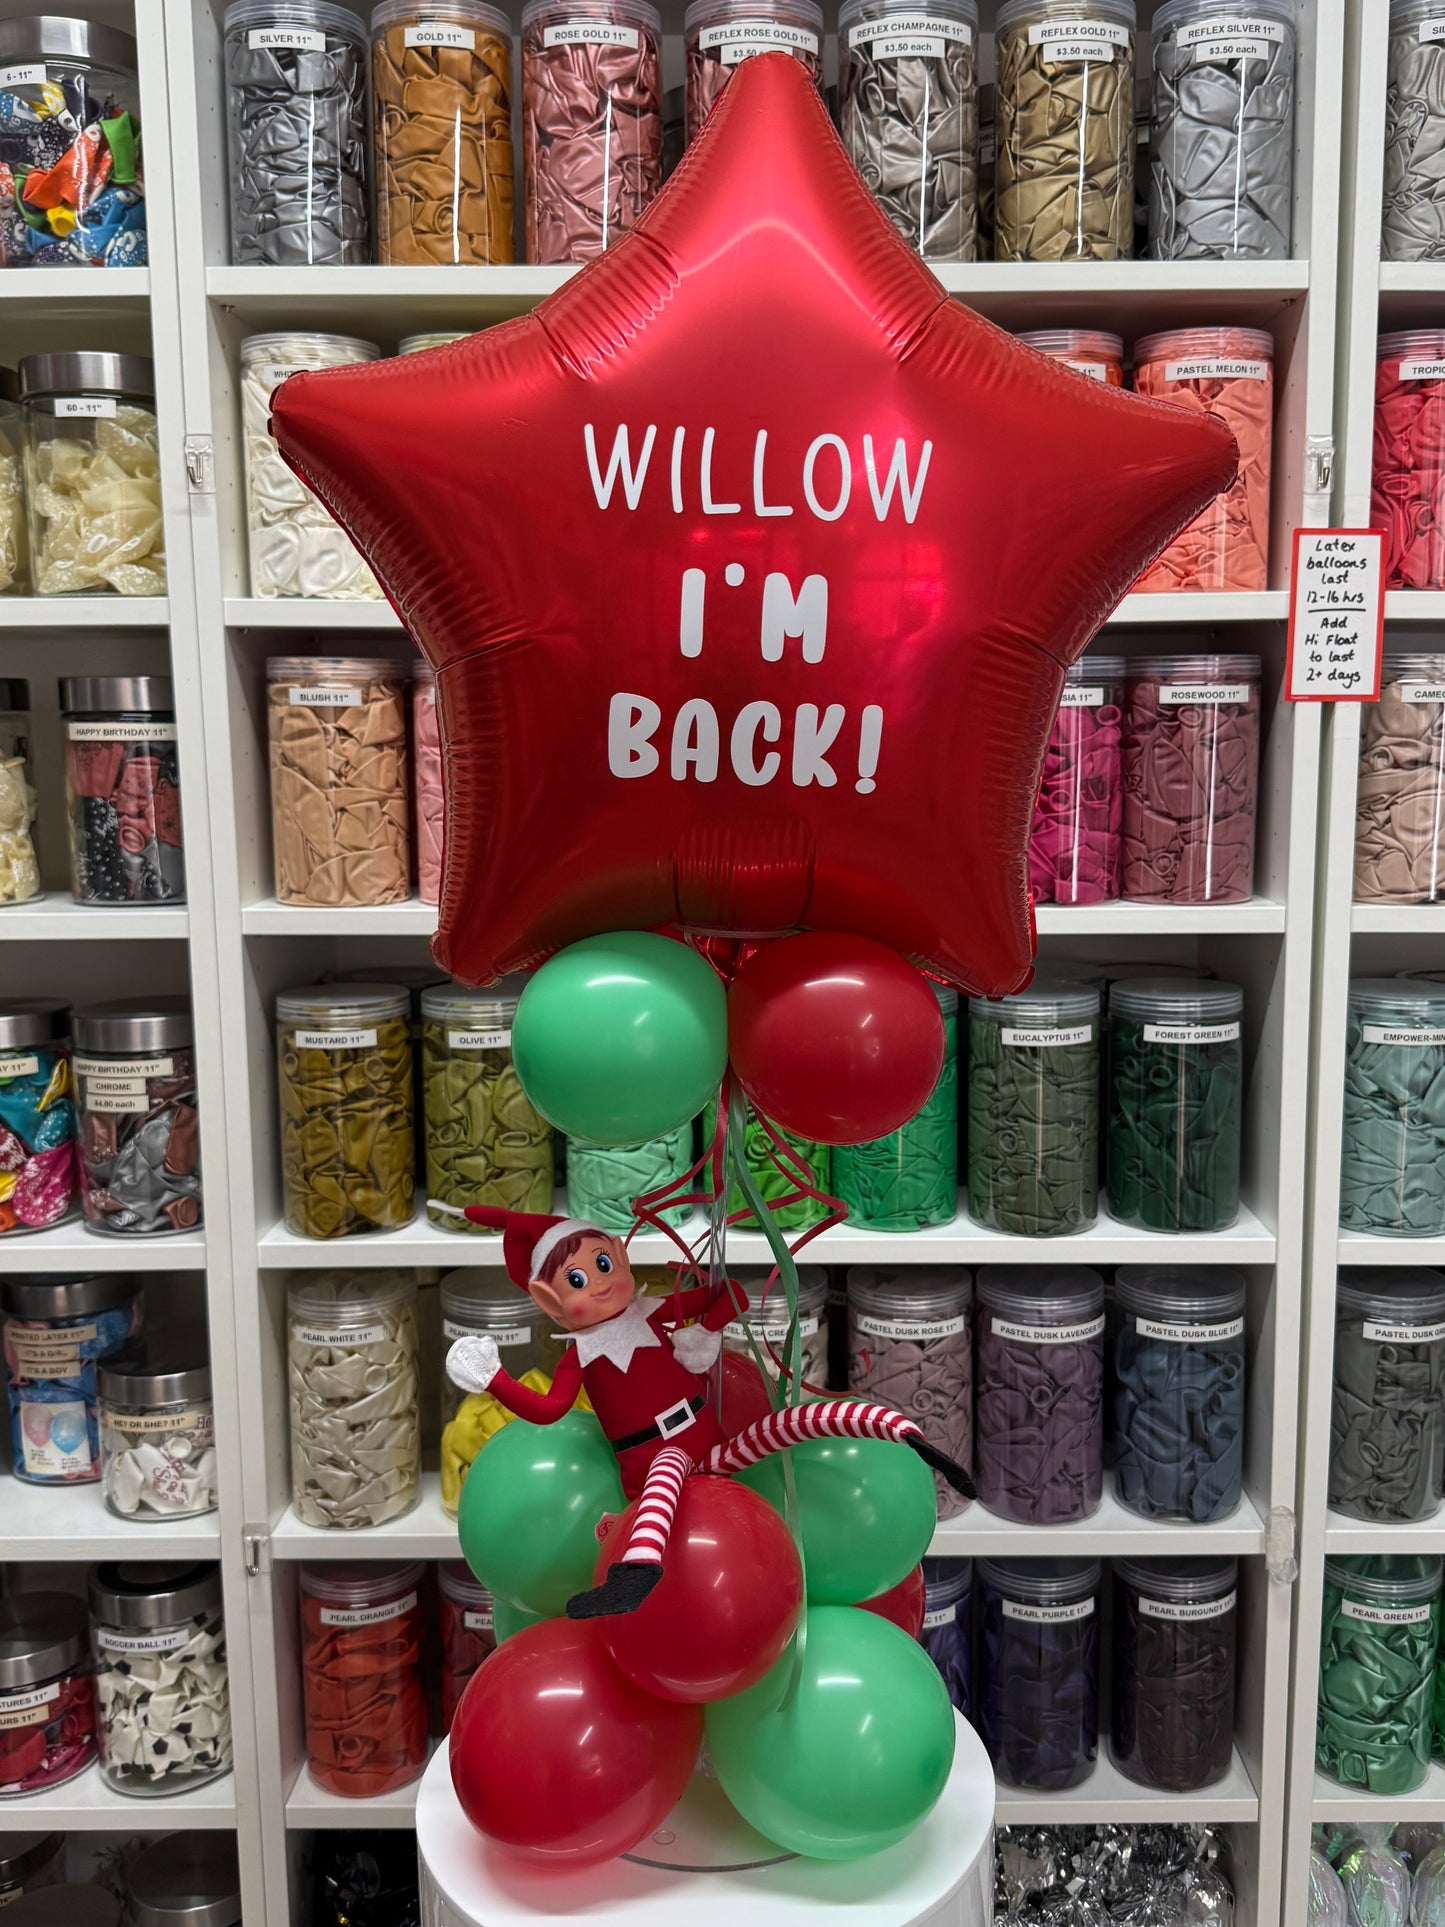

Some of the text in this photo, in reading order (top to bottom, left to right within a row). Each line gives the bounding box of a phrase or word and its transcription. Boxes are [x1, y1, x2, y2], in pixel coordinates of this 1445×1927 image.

[555, 30, 627, 41] ROSE GOLD 11"
[709, 30, 741, 42] REFLEX
[744, 29, 771, 38] ROSE
[774, 30, 798, 41] GOLD
[857, 25, 889, 39] REFLEX
[891, 23, 950, 34] CHAMPAGNE
[1041, 27, 1120, 39] REFLEX GOLD 11"
[1188, 25, 1275, 39] REFLEX SILVER 11"
[260, 35, 311, 44] SILVER 11"
[417, 33, 461, 42] GOLD 11"
[885, 43, 908, 52] $3.50
[1056, 47, 1103, 56] $3.50 each
[1209, 46, 1257, 55] $3.50 each
[1176, 365, 1260, 375] PASTEL MELON 11"
[584, 423, 932, 524] WILLOW
[1306, 557, 1366, 569] balloons
[1321, 570, 1349, 584] last
[1306, 591, 1364, 603] 12-16 hrs
[680, 563, 828, 663] I'M
[1320, 616, 1348, 628] Add
[1305, 632, 1358, 646] Hi Float
[1309, 649, 1355, 662] to last
[1306, 668, 1361, 689] 2+ days
[300, 694, 349, 702] BLUSH 11"
[1062, 694, 1092, 702] SIA 11"
[1171, 690, 1240, 700] ROSEWOOD 11"
[76, 728, 101, 736] HAPPY
[103, 728, 150, 736] BIRTHDAY
[608, 692, 883, 794] BACK!
[305, 1036, 348, 1045] MUSTARD
[460, 1036, 485, 1044] OLIVE
[1013, 1033, 1071, 1042] EUCALYPTUS
[1155, 1031, 1191, 1040] FOREST
[1194, 1030, 1222, 1039] GREEN
[77, 1063, 97, 1072] HAPPY
[97, 1065, 142, 1074] BIRTHDAY
[96, 1083, 132, 1091] CHROME
[115, 1100, 135, 1108] each
[864, 1321, 893, 1334] PASTEL
[895, 1327, 919, 1335] DUSK
[921, 1326, 944, 1335] ROSE
[1001, 1325, 1032, 1338] PASTEL
[1034, 1330, 1058, 1339] DUSK
[1060, 1324, 1097, 1339] LAVENDER
[1146, 1325, 1179, 1337] PASTEL
[1181, 1330, 1206, 1338] DUSK
[1208, 1327, 1229, 1337] BLUE
[303, 1332, 326, 1342] PEARL
[328, 1334, 358, 1342] WHITE
[1375, 1329, 1410, 1339] PASTEL
[1412, 1330, 1434, 1339] DUSK
[330, 1614, 358, 1622] PEARL
[359, 1607, 396, 1621] ORANGE
[1013, 1607, 1040, 1618] PEARL
[1042, 1609, 1073, 1618] PURPLE
[1149, 1604, 1177, 1616] PEARL
[1179, 1602, 1223, 1616] BURGUNDY
[1352, 1607, 1380, 1619] PEARL
[1383, 1612, 1413, 1621] GREEN
[104, 1638, 140, 1649] SOCCER
[142, 1640, 165, 1649] BALL
